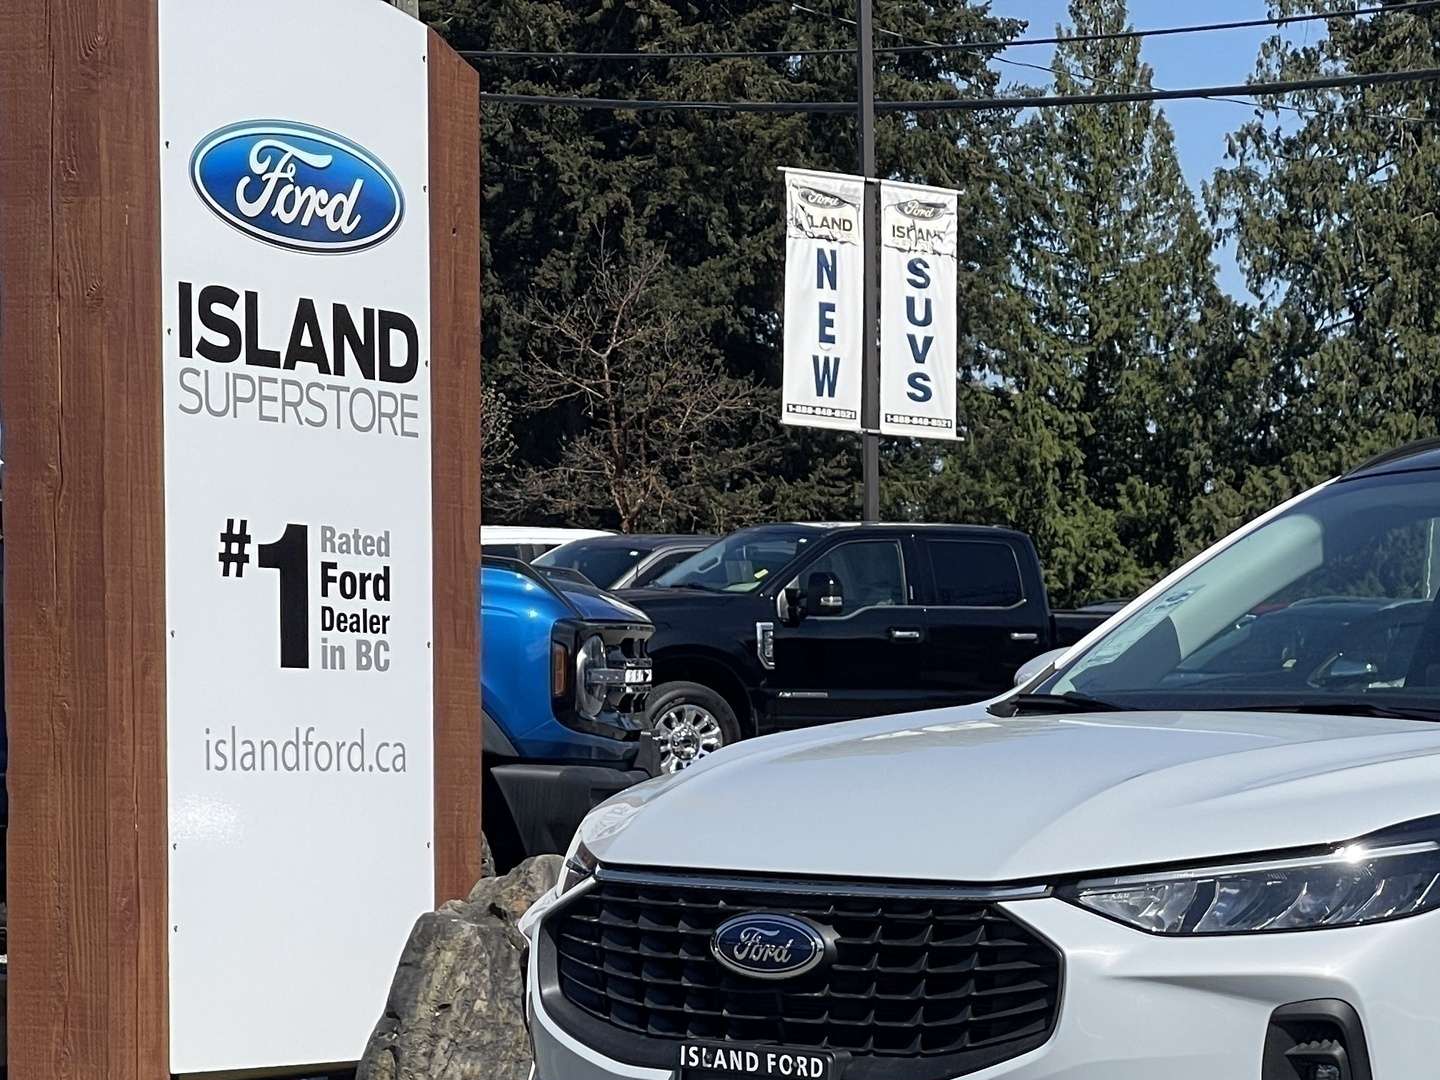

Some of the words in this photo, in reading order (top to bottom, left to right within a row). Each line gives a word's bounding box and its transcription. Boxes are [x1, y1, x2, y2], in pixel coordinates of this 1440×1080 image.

[235, 138, 364, 235] Ford
[806, 214, 853, 232] LAND
[904, 200, 935, 218] Ford
[178, 281, 419, 384] ISLAND
[811, 247, 841, 398] NEW
[905, 256, 934, 402] SUVS
[178, 367, 419, 438] SUPERSTORE
[320, 525, 390, 557] Rated
[320, 561, 390, 602] Ford
[320, 605, 390, 634] Dealer
[320, 637, 345, 670] in
[355, 639, 390, 672] BC
[205, 725, 407, 773] islandford.ca
[733, 926, 794, 963] Ford
[680, 1045, 759, 1072] ISLAND
[767, 1053, 824, 1079] FORD
